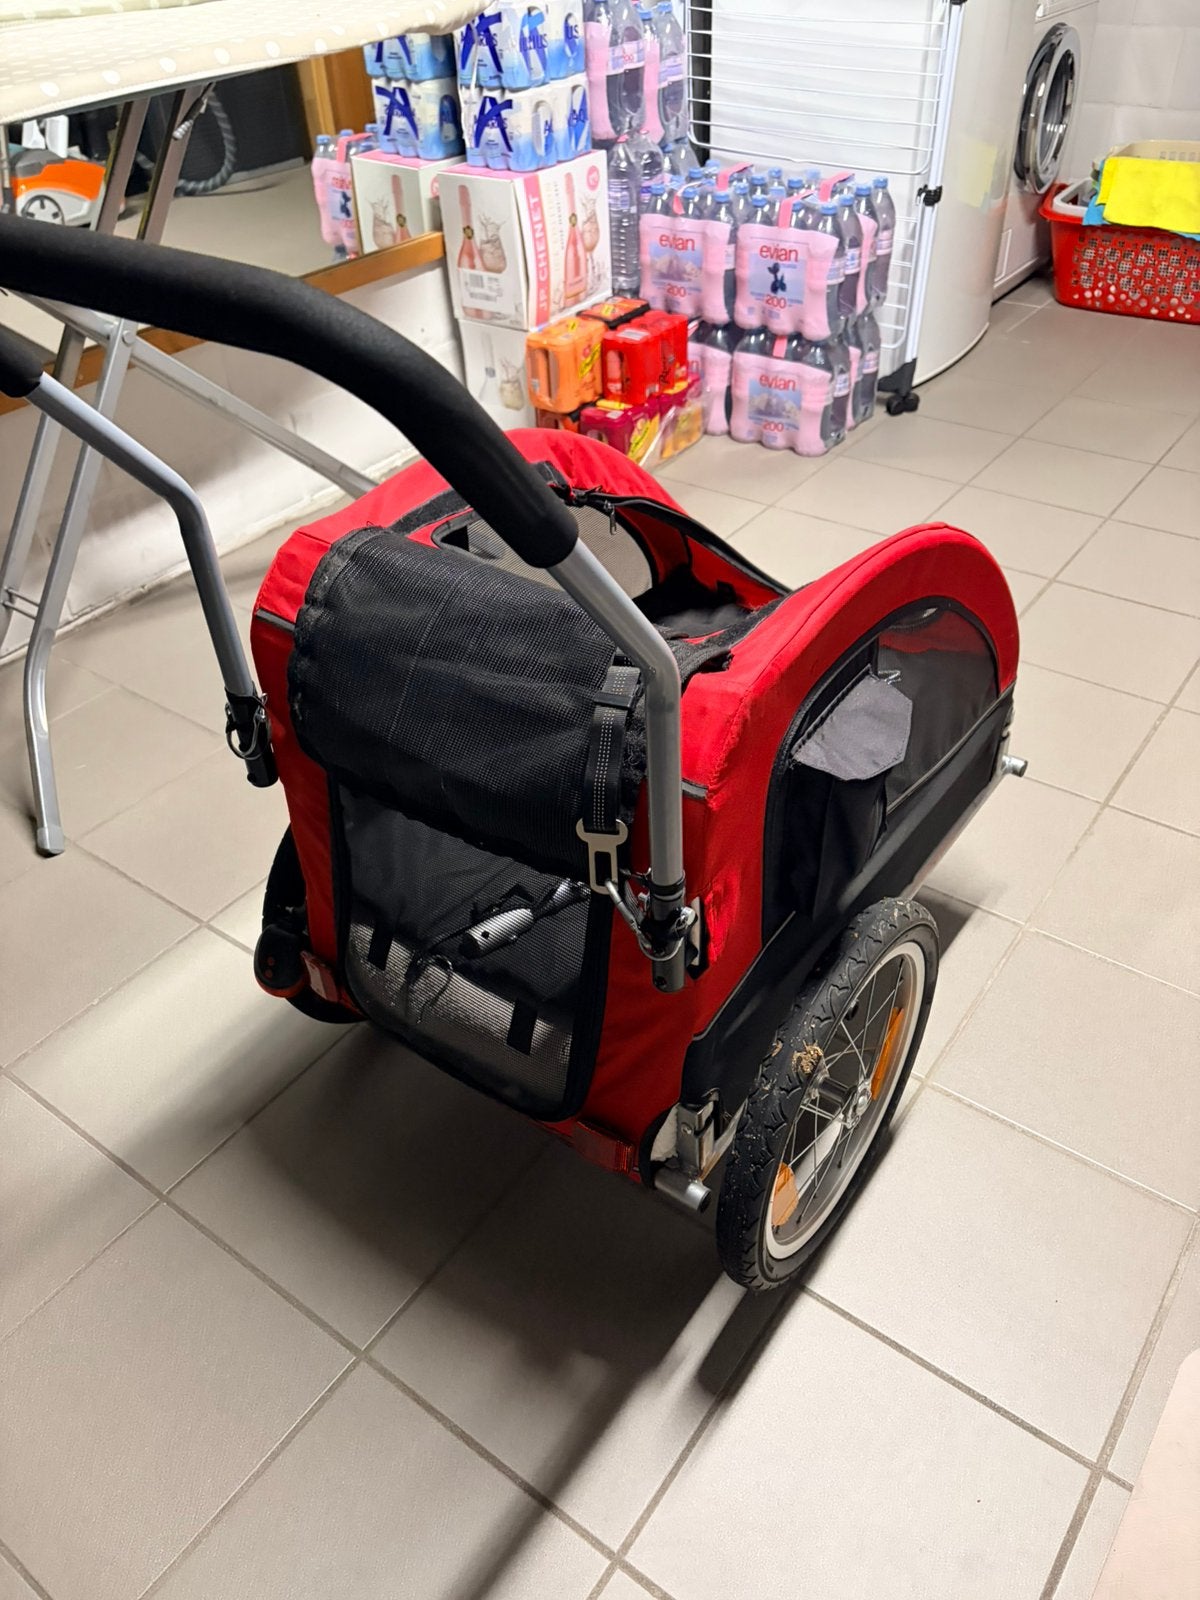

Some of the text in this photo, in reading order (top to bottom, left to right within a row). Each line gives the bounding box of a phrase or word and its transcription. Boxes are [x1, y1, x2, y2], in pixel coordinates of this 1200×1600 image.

[528, 194, 548, 282] CHENET
[658, 232, 696, 251] evian
[759, 244, 799, 263] evian
[666, 283, 687, 298] 200
[764, 295, 787, 309] 200
[759, 372, 797, 391] evian
[762, 420, 785, 433] 200
